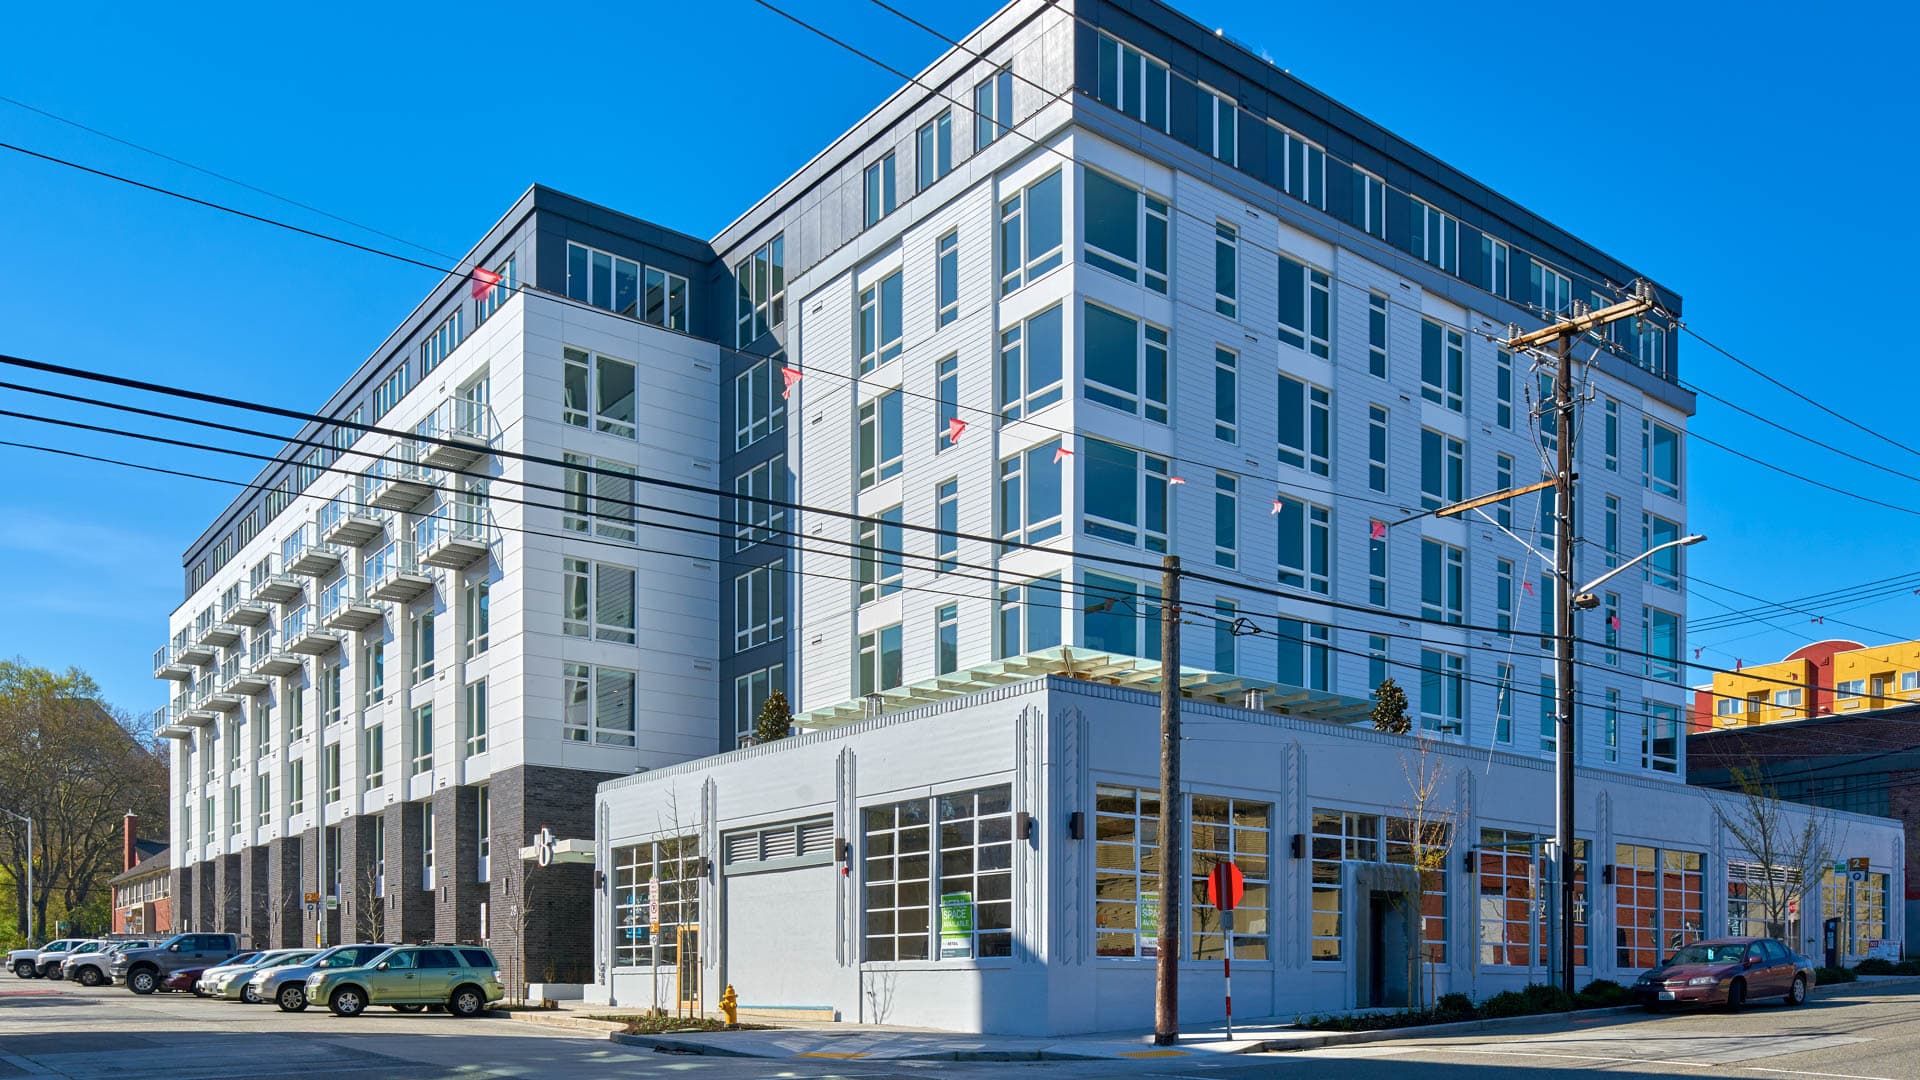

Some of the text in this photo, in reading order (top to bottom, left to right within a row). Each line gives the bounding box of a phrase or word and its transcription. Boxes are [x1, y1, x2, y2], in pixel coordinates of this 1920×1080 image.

[943, 909, 966, 920] SPACE
[1143, 909, 1159, 919] SPA
[943, 919, 969, 928] AVAILABLE
